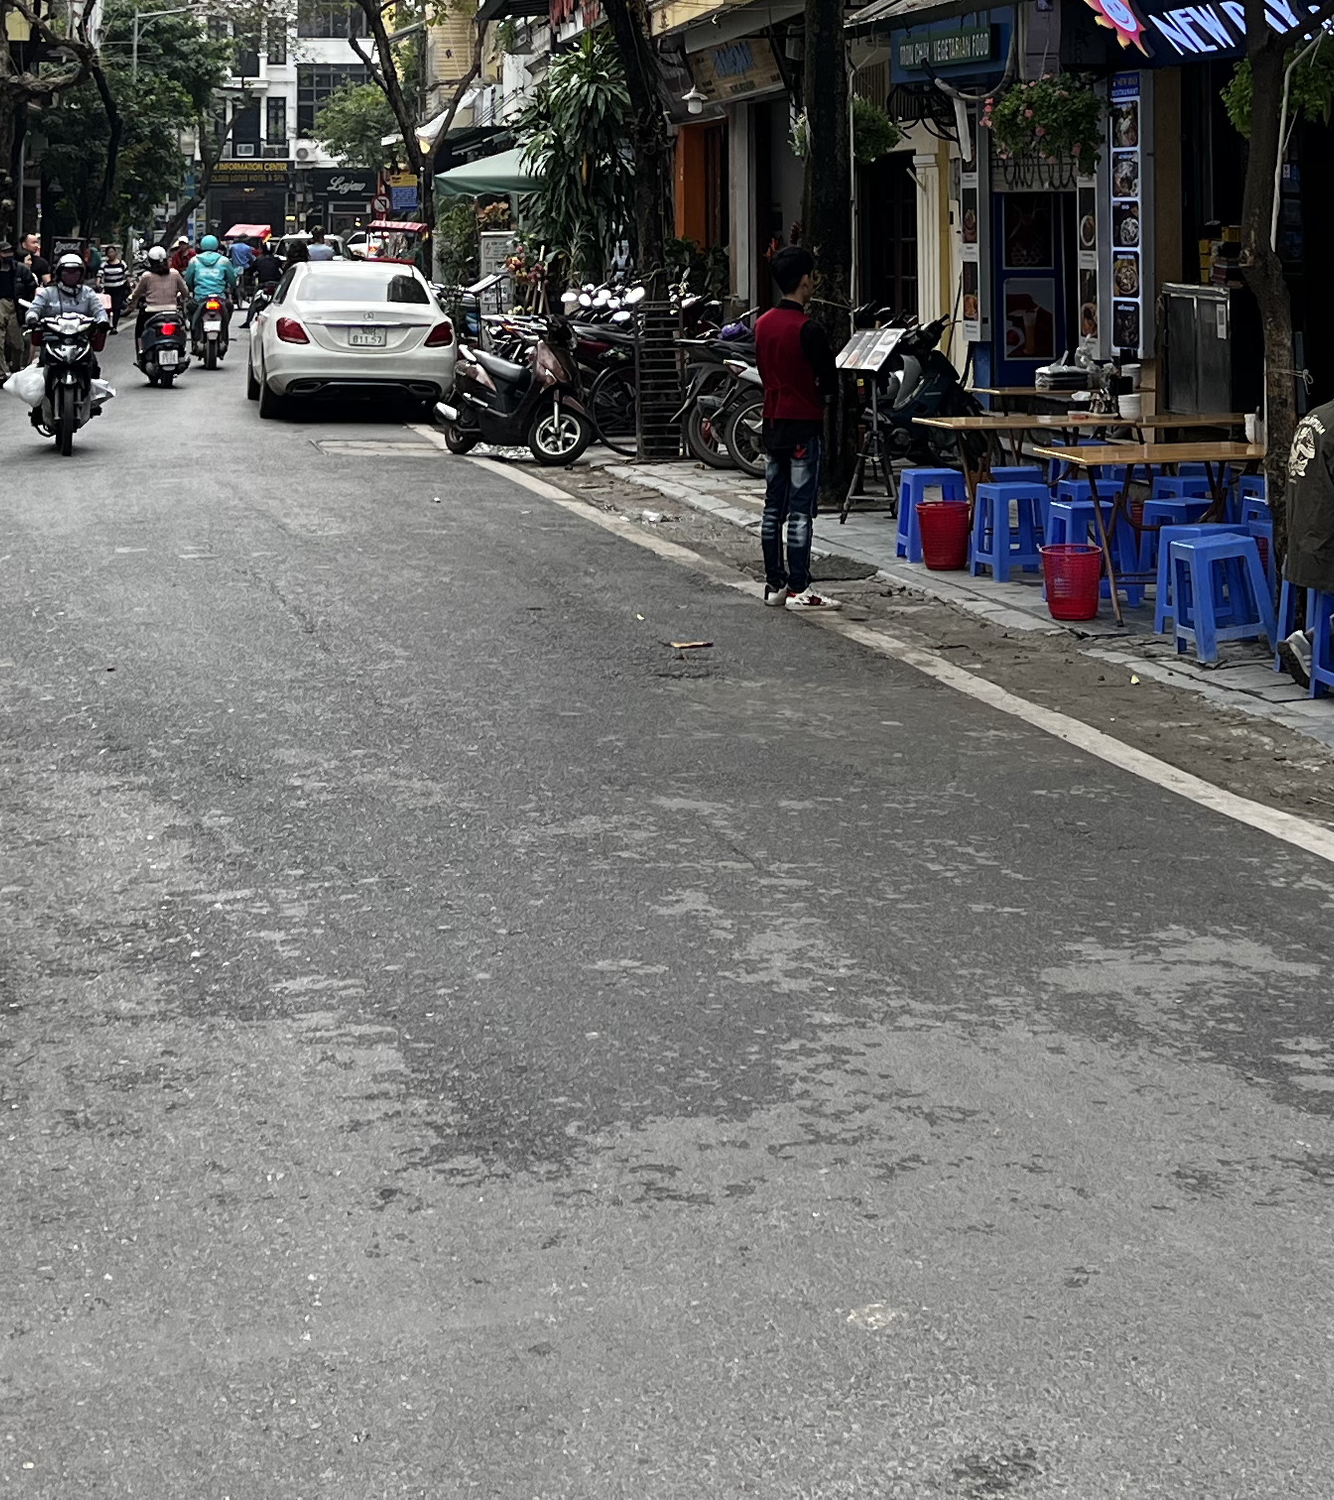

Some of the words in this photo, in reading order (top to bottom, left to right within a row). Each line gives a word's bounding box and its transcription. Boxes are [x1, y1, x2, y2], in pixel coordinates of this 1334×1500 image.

[1147, 2, 1236, 55] NEW
[218, 162, 263, 171] INFORMATION
[264, 162, 288, 171] CENTER
